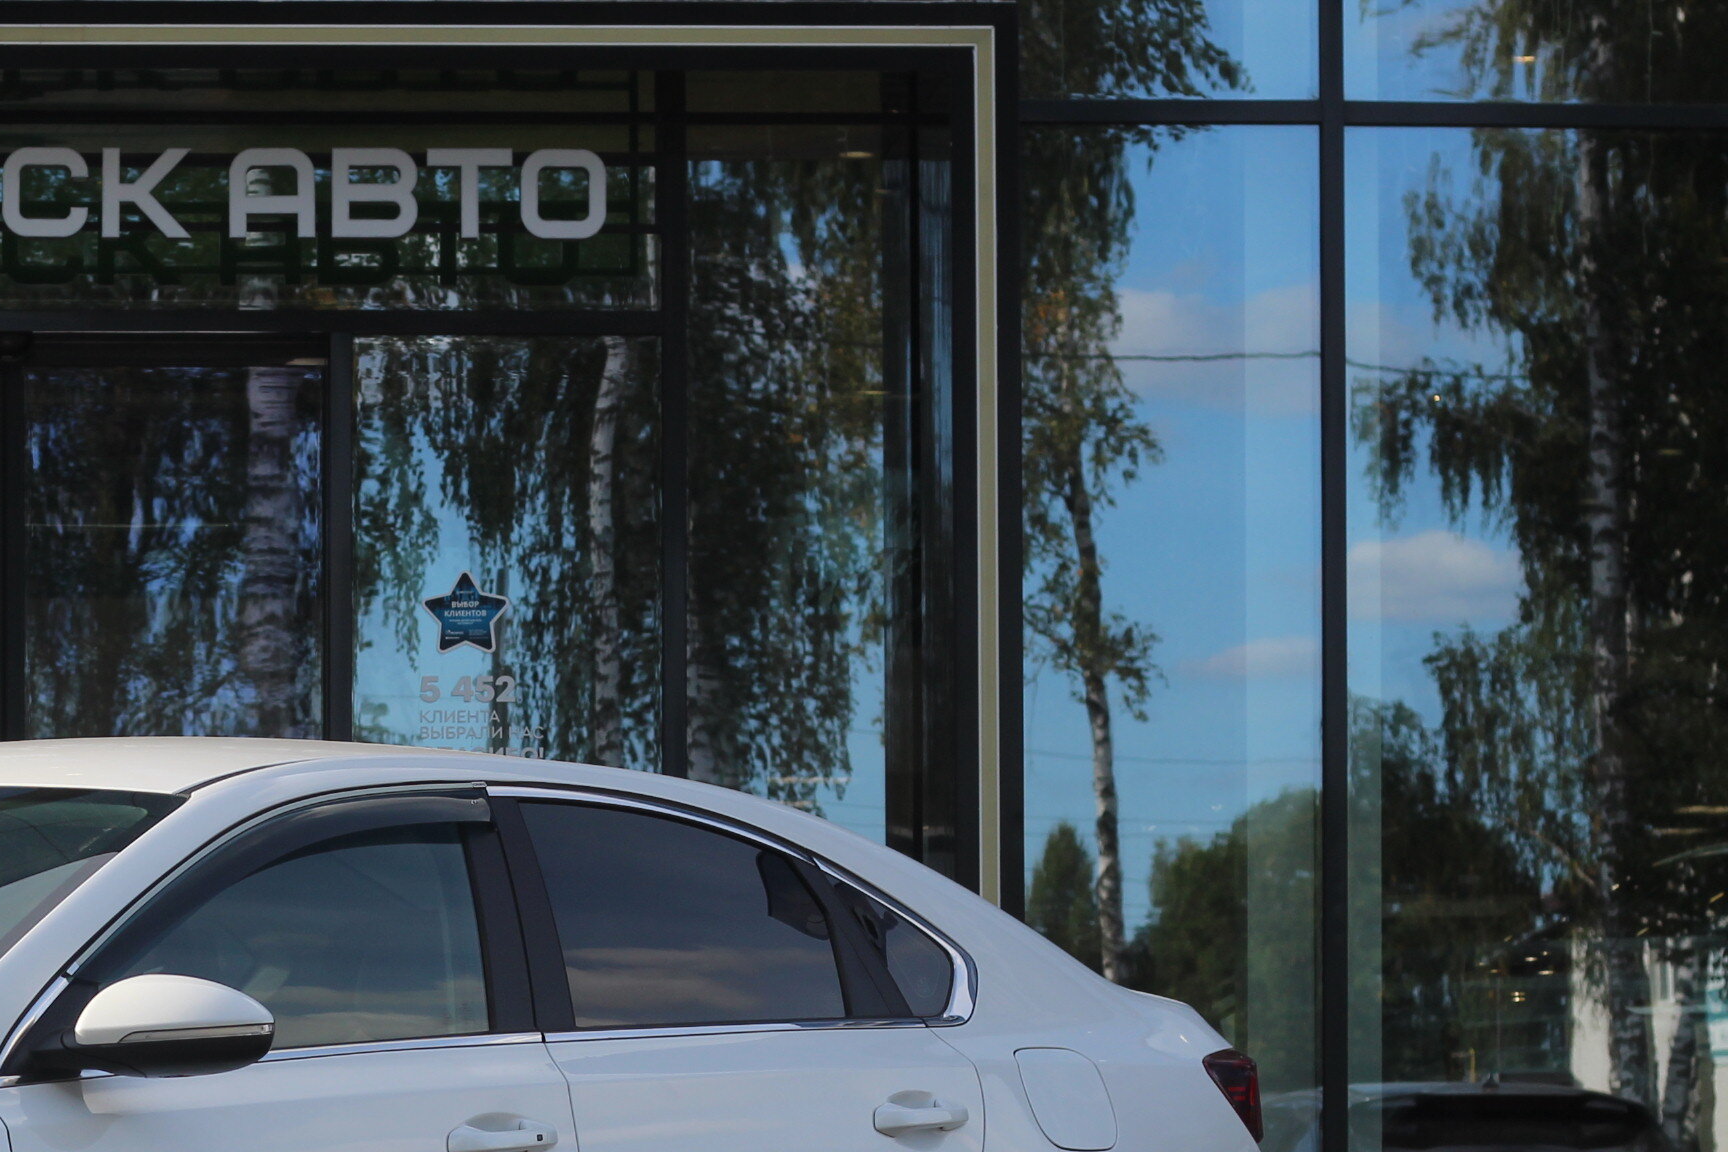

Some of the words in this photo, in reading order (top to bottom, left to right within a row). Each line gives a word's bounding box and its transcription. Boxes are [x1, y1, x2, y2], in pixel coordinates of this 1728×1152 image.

[228, 147, 608, 239] АВТО
[451, 601, 480, 609] ВЫБОР
[444, 609, 487, 617] КЛИЕНТОВ
[420, 676, 441, 703] 5
[450, 675, 516, 703] 452
[420, 710, 501, 724] КЛИЕНТА
[420, 726, 503, 740] ВЫБРАЛИ
[508, 726, 545, 739] НАС
